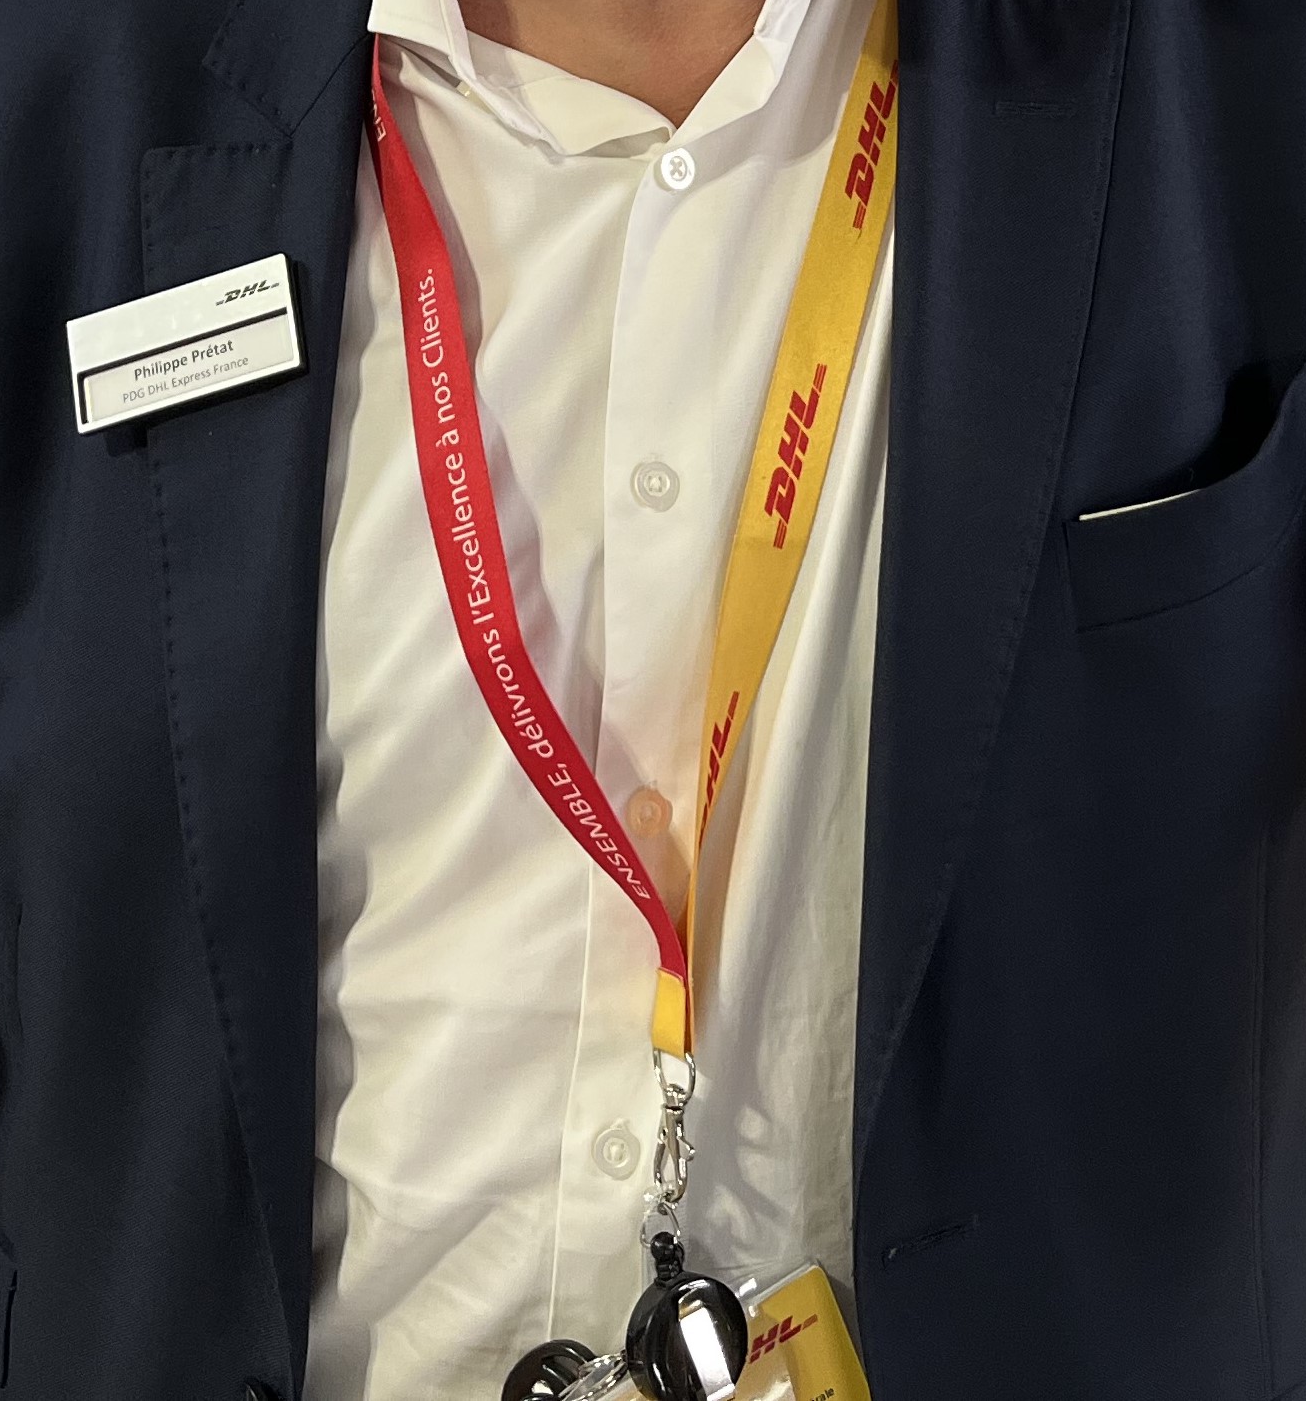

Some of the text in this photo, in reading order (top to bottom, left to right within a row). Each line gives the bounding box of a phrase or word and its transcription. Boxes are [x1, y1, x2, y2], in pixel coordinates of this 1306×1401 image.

[844, 72, 898, 216] DHL
[220, 279, 276, 305] DHL
[123, 357, 249, 403] PDG DHL Express France
[134, 340, 234, 381] Philippe Prétat
[764, 374, 825, 536] DHL
[417, 268, 651, 899] ENSEMBLE, délivrons l'Excellence à nos Clients.
[748, 1314, 808, 1364] HL
